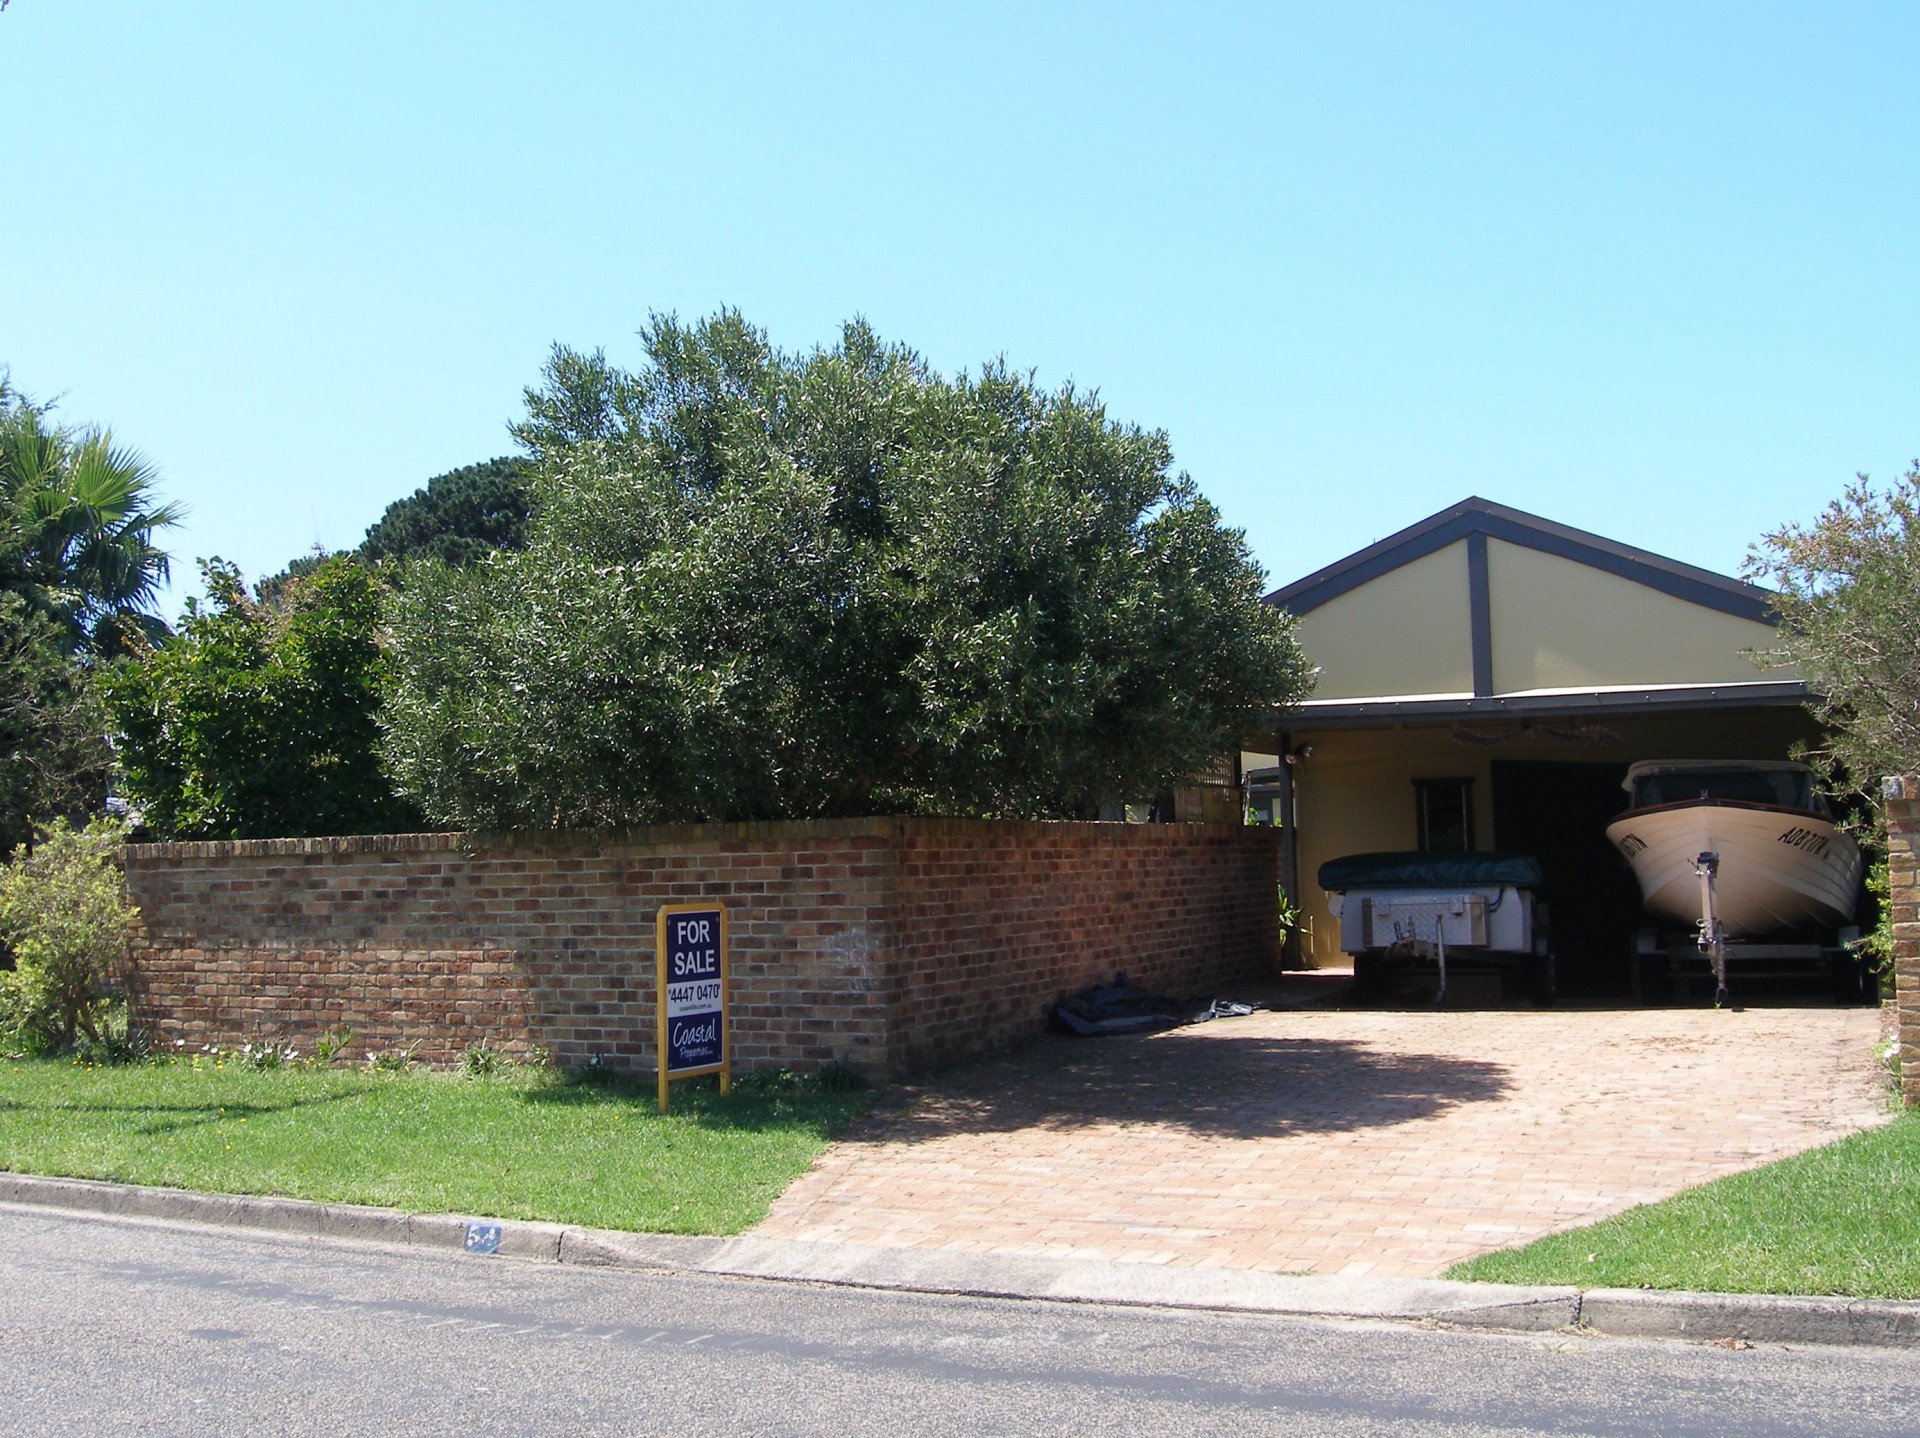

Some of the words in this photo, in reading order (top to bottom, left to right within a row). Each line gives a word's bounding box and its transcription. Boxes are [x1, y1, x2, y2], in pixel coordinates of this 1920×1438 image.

[677, 920, 711, 945] FOR
[674, 949, 716, 976] SALE
[670, 986, 695, 1003] 4447
[696, 983, 719, 1001] 0470
[673, 1017, 717, 1048] Coastal
